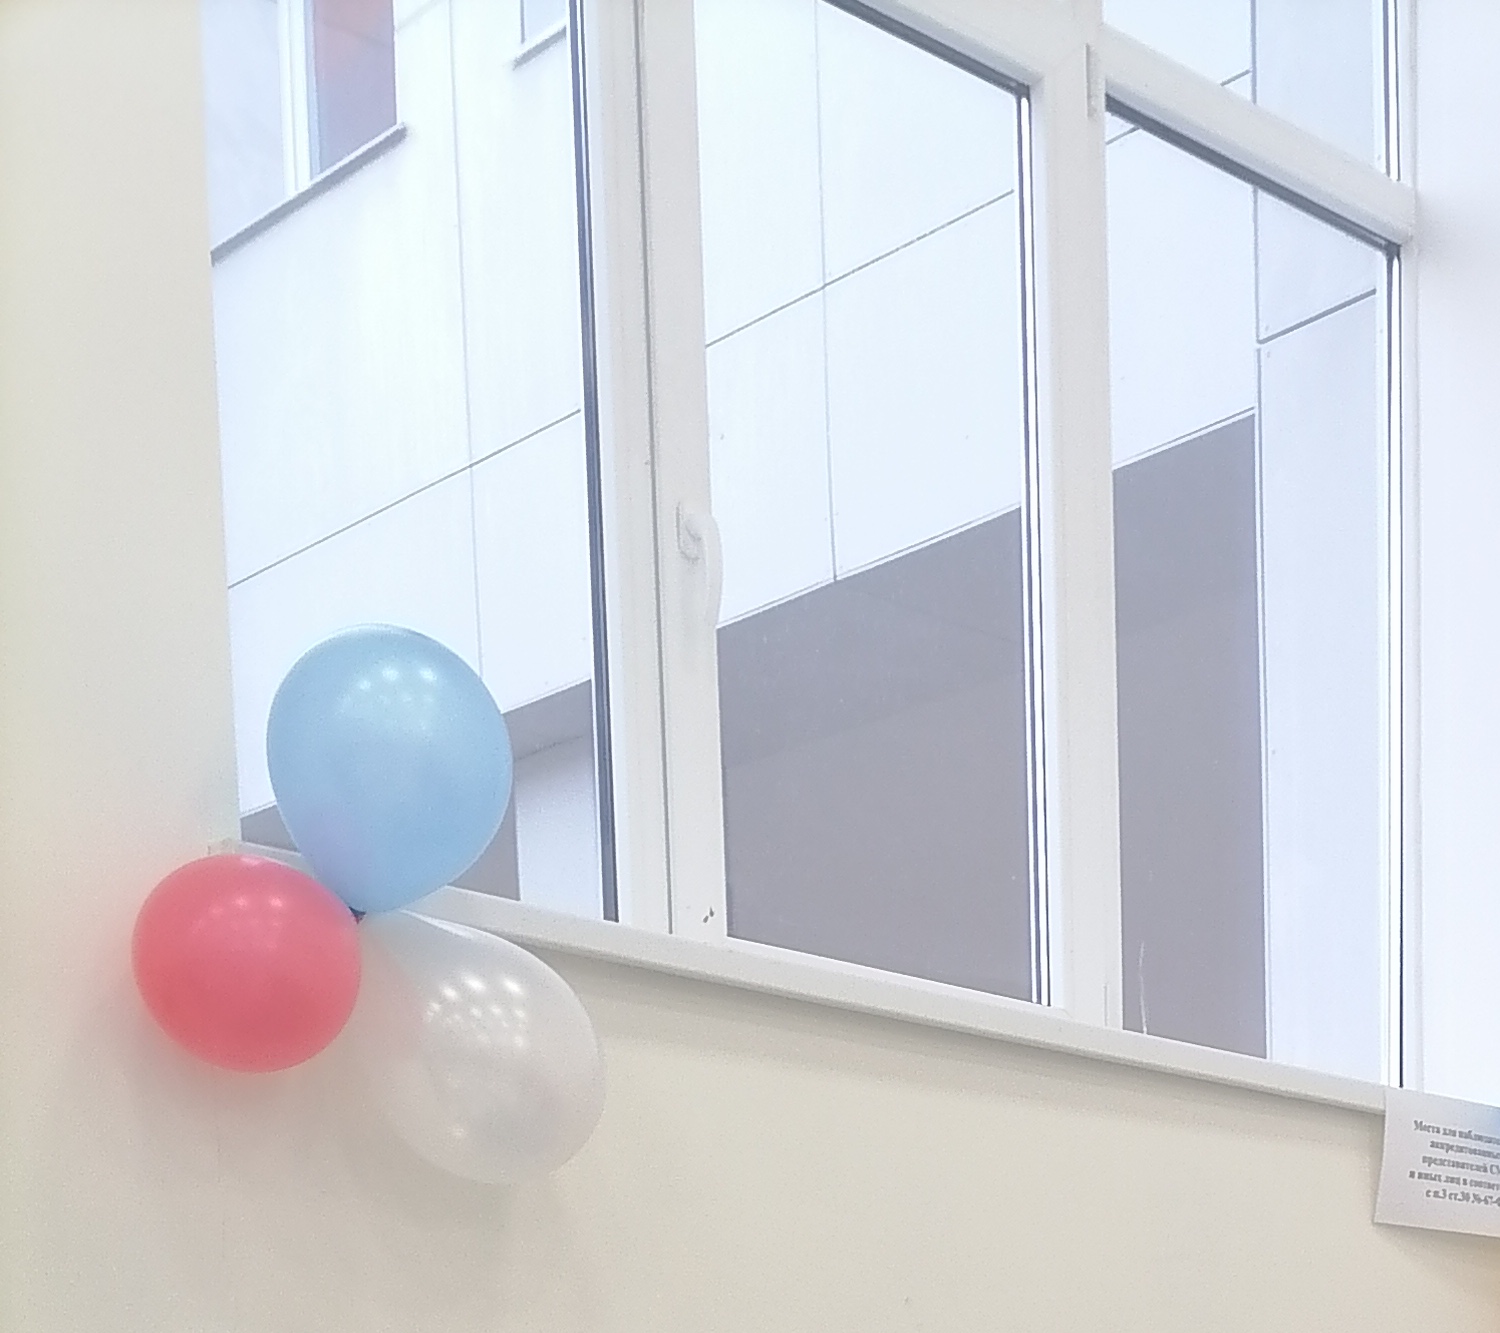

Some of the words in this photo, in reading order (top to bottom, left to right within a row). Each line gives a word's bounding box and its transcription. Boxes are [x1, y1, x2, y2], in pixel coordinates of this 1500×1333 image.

[1413, 1119, 1441, 1135] Места
[1442, 1127, 1457, 1138] для
[1422, 1155, 1488, 1173] представителей
[1408, 1170, 1416, 1179] и
[1417, 1171, 1442, 1183] иных
[1425, 1189, 1432, 1198] с
